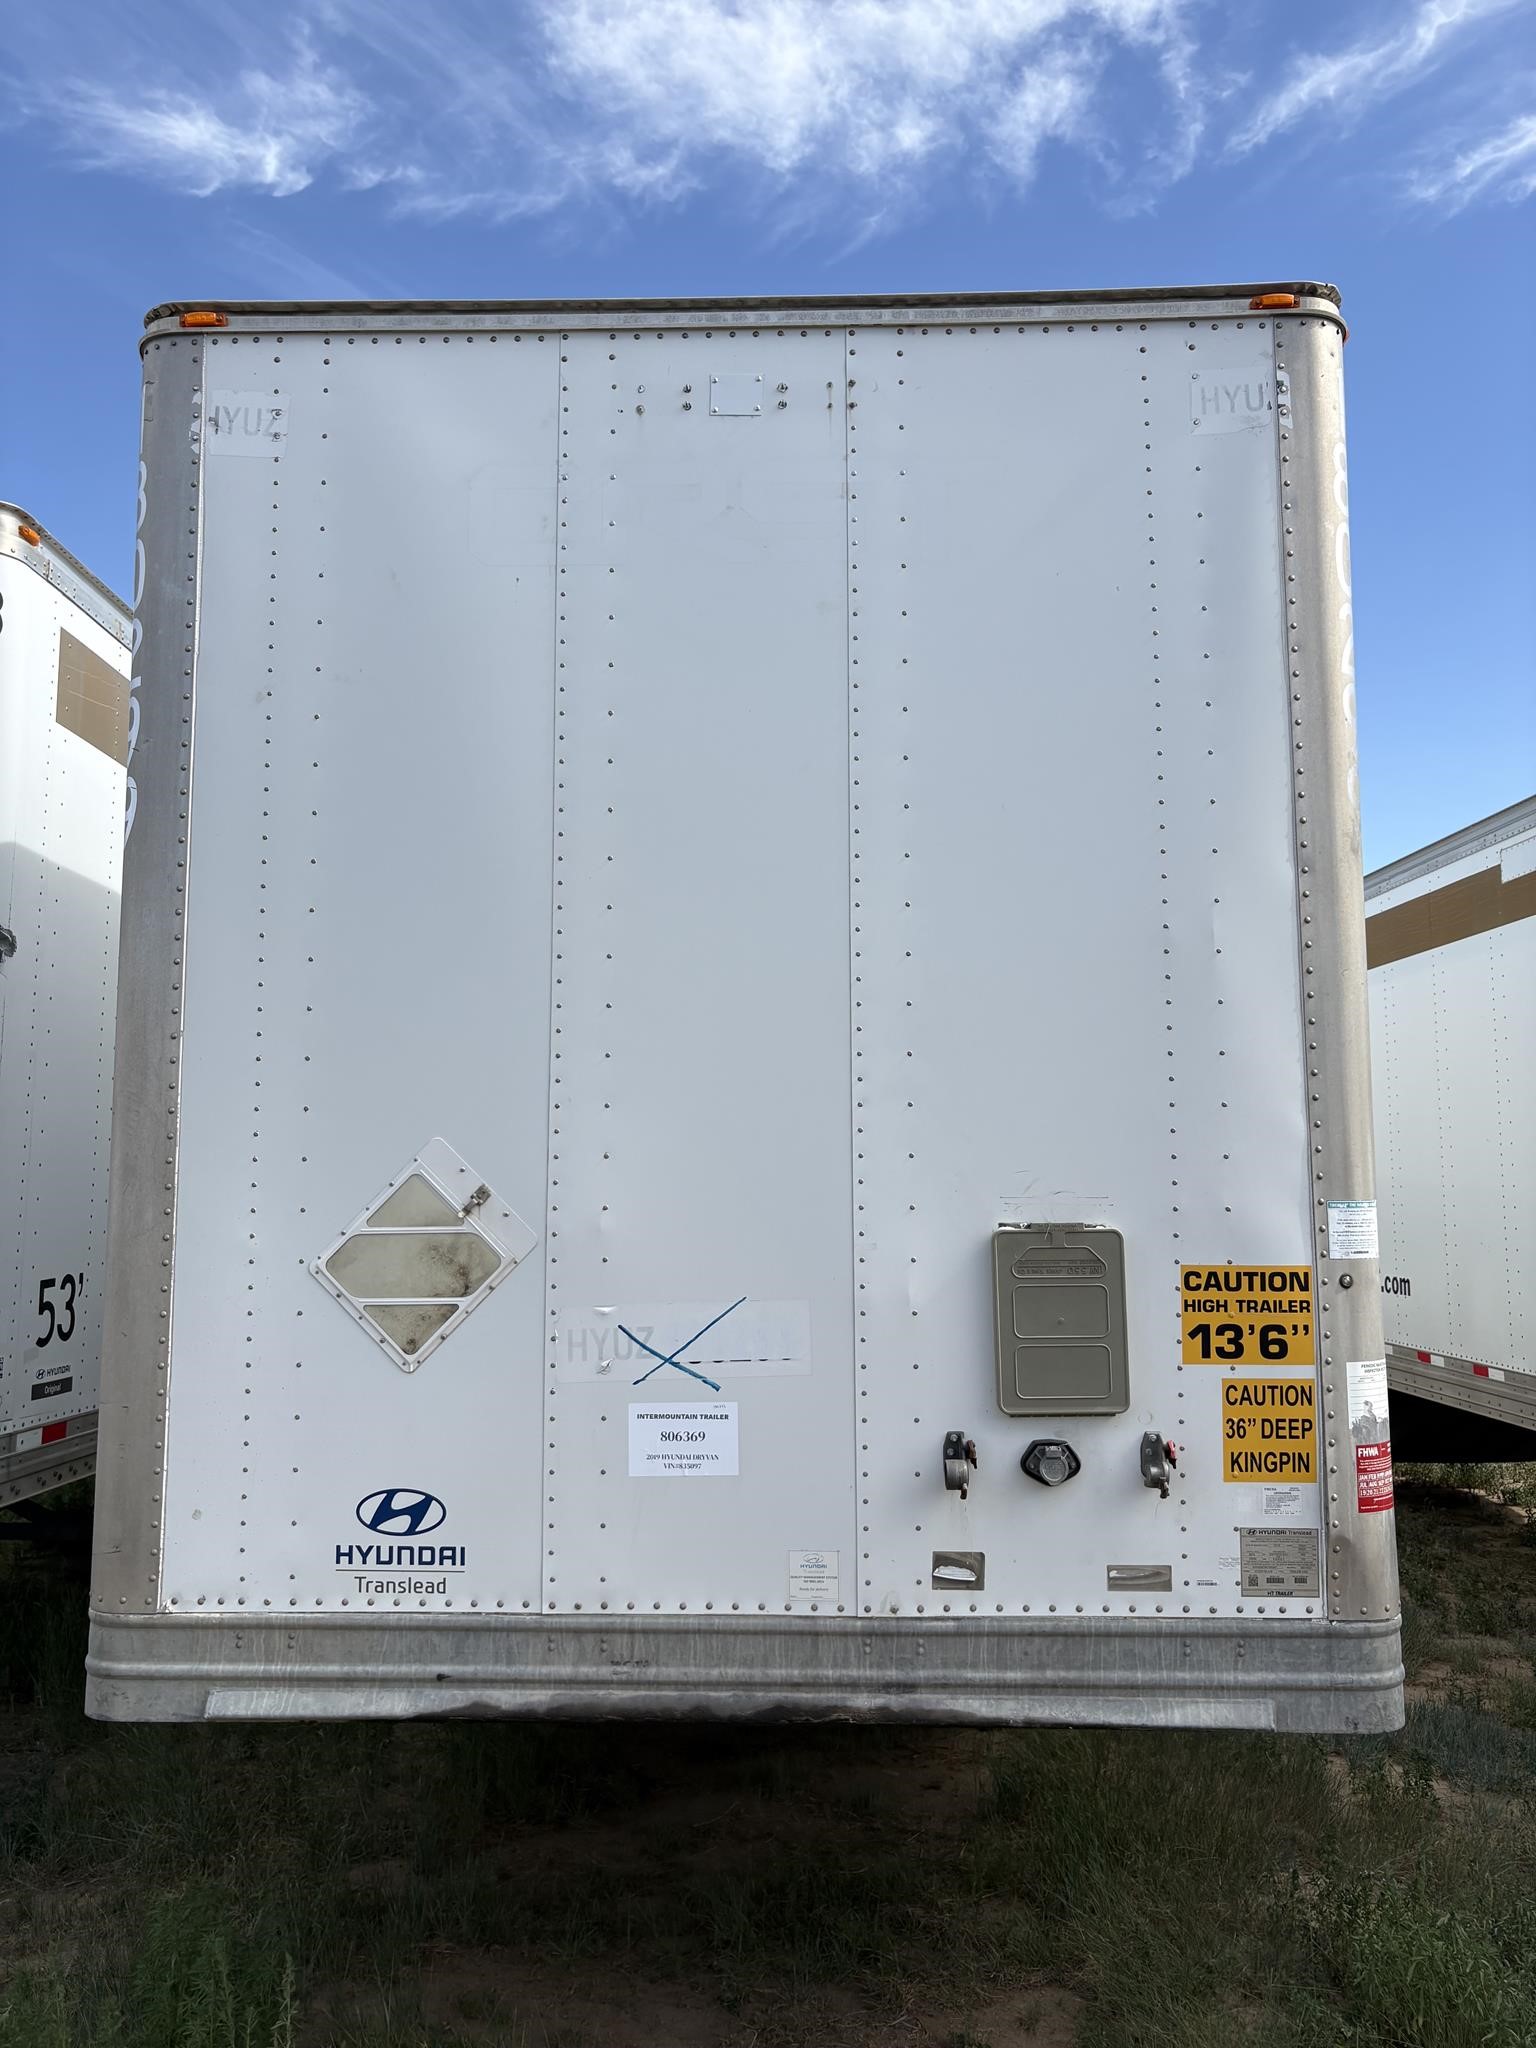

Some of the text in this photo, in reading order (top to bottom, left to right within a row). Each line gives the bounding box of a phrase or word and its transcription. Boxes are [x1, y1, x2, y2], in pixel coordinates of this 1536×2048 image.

[1200, 382, 1271, 415] HYU
[1183, 1270, 1310, 1292] CAUTION
[35, 1272, 84, 1348] 53'
[1183, 1299, 1311, 1313] HIGH TRAILER
[567, 1326, 655, 1363] HYUZ
[1225, 1385, 1312, 1406] CAUTION
[660, 1430, 706, 1442] 806369
[1261, 1418, 1313, 1440] DEEP
[1231, 1452, 1310, 1473] KINGPIN
[1357, 1446, 1379, 1458] FHWA
[336, 1545, 465, 1566] HYUNDAI
[354, 1576, 447, 1594] Translead
